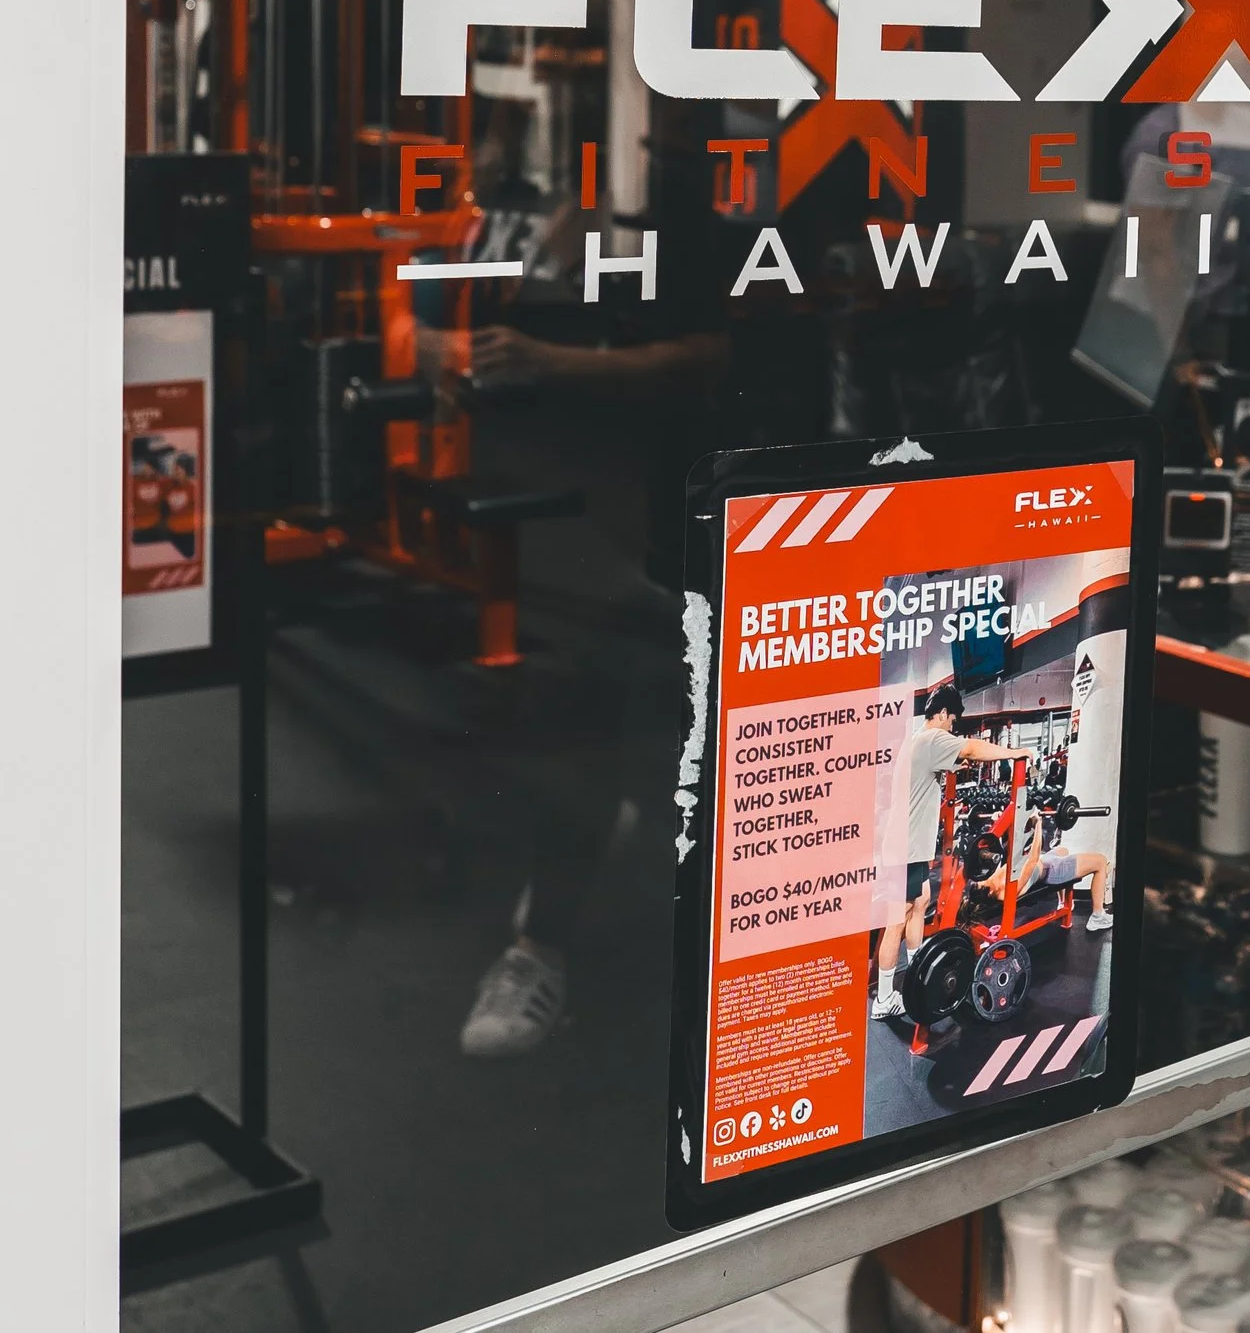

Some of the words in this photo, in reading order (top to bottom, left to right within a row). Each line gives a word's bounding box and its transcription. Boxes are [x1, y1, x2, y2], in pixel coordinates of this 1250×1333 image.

[583, 213, 1212, 303] HAWAII
[1027, 514, 1088, 529] HAWAII
[741, 594, 849, 638] BETTER
[856, 574, 1005, 621] TOGETHER
[738, 618, 933, 673] MEMBERSHIP
[940, 601, 1053, 644] SPECIAL
[735, 720, 773, 741] JOIN
[777, 707, 861, 734] TOGETHER,
[865, 700, 905, 722] STAY
[735, 735, 834, 765] CONSISTENT
[735, 762, 820, 789] TOGETHER.
[824, 748, 892, 774] COUPLES
[734, 792, 774, 813] WHO
[778, 781, 833, 805] SWEAT
[733, 809, 819, 837] TOGETHER,
[732, 838, 778, 862] STICK
[782, 823, 861, 852] TOGETHER
[730, 886, 778, 910] BOGO
[782, 866, 877, 901] $40/MONTH
[730, 913, 760, 933] FOR
[765, 905, 799, 925] ONE
[803, 897, 843, 917] YEAR
[748, 977, 767, 988] applies
[795, 963, 830, 977] memberships
[830, 960, 844, 968] billed
[767, 963, 802, 977] memberships
[818, 956, 833, 964] BOGO
[718, 991, 740, 1001] together
[754, 983, 771, 991] twelve
[784, 977, 801, 985] month
[718, 1006, 732, 1014] billed
[750, 998, 765, 1006] credit
[786, 988, 808, 999] payment
[831, 978, 852, 989] Monthly
[718, 994, 753, 1009] memberships
[754, 991, 768, 999] must
[777, 984, 798, 994] enrolled
[718, 1013, 730, 1021] dues
[741, 1006, 762, 1017] charged
[772, 996, 808, 1010] preauthorized
[809, 990, 834, 1000] electronic
[743, 1013, 758, 1021] Taxes
[716, 1043, 749, 1056] membership
[781, 1027, 813, 1041] Membership
[814, 1022, 835, 1032] includes
[717, 1031, 741, 1042] Members
[742, 1027, 756, 1036] must
[793, 1016, 807, 1025] years
[717, 1041, 731, 1050] years
[758, 1030, 775, 1040] parent
[782, 1025, 795, 1034] legal
[796, 1019, 819, 1031] guardian
[716, 1053, 736, 1063] general
[770, 1038, 796, 1049] additional
[797, 1033, 818, 1042] services
[716, 1059, 738, 1069] included
[750, 1052, 769, 1062] require
[770, 1046, 792, 1057] separate
[794, 1040, 817, 1051] purchase
[715, 1069, 751, 1085] Memberships
[803, 1053, 816, 1061] Offer
[817, 1048, 835, 1058] cannot
[715, 1079, 741, 1090] combined
[742, 1075, 754, 1083] with
[754, 1072, 768, 1080] other
[769, 1064, 799, 1078] promotions
[834, 1052, 847, 1060] Offer
[747, 1080, 766, 1088] current
[793, 1065, 824, 1077] Restrictions
[714, 1092, 742, 1103] Promotion
[743, 1087, 763, 1098] subject
[771, 1080, 789, 1091] change
[808, 1071, 827, 1080] without
[827, 1068, 839, 1076] prior
[758, 1091, 771, 1099] desk
[713, 1124, 839, 1168] FLEXXFITNESSHAWAII.COM
